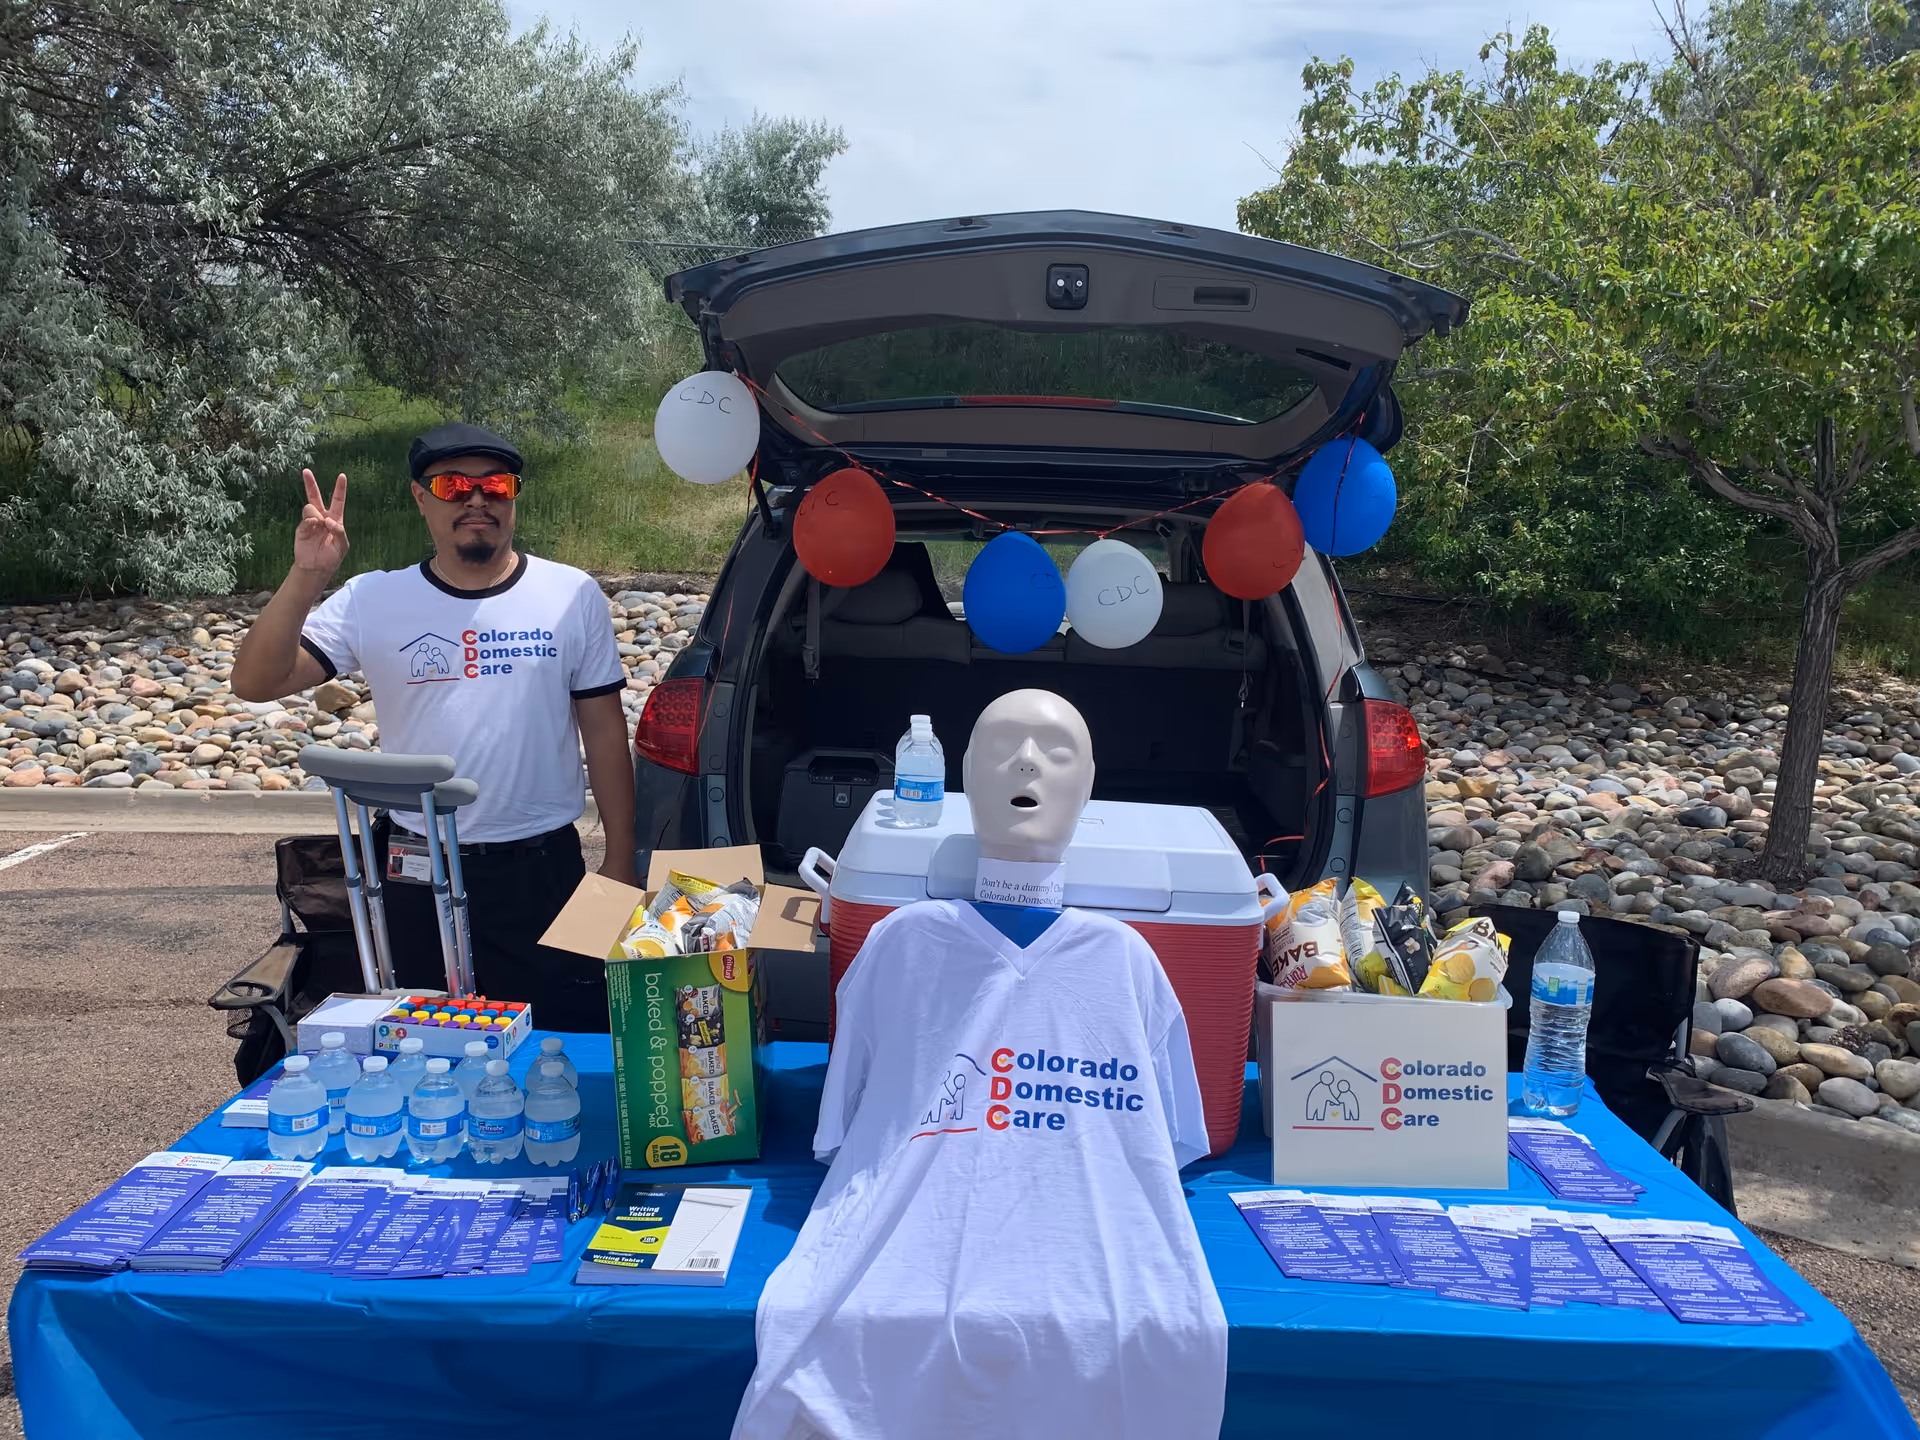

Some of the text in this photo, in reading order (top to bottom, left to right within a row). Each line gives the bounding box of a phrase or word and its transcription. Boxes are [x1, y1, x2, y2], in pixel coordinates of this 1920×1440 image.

[679, 386, 732, 414] CDC
[1097, 575, 1150, 606] CDC
[461, 628, 553, 646] Colorado
[464, 644, 557, 662] Domestic
[463, 662, 513, 679] Care
[980, 889, 1016, 903] Colorado
[1017, 894, 1053, 905] Domestic
[981, 877, 1000, 888] Don't
[1002, 880, 1012, 890] be
[1021, 881, 1053, 894] dummy!
[644, 973, 667, 1032] baked
[701, 990, 709, 1015] BAKED
[650, 1036, 668, 1051] &
[707, 1050, 715, 1075] BAKED
[991, 1047, 1139, 1082] Colorado
[1380, 1056, 1487, 1081] Colorado
[647, 1055, 674, 1128] popped
[990, 1076, 1144, 1112] Domestic
[1382, 1082, 1494, 1105] Domestic
[648, 1113, 657, 1128] MIX
[708, 1109, 720, 1136] BAKED
[986, 1104, 1066, 1131] Care
[1380, 1107, 1440, 1131] Care
[651, 1144, 660, 1163] BAGS
[659, 1143, 682, 1163] 18
[629, 1205, 660, 1213] Writing
[593, 1254, 621, 1262] Writing
